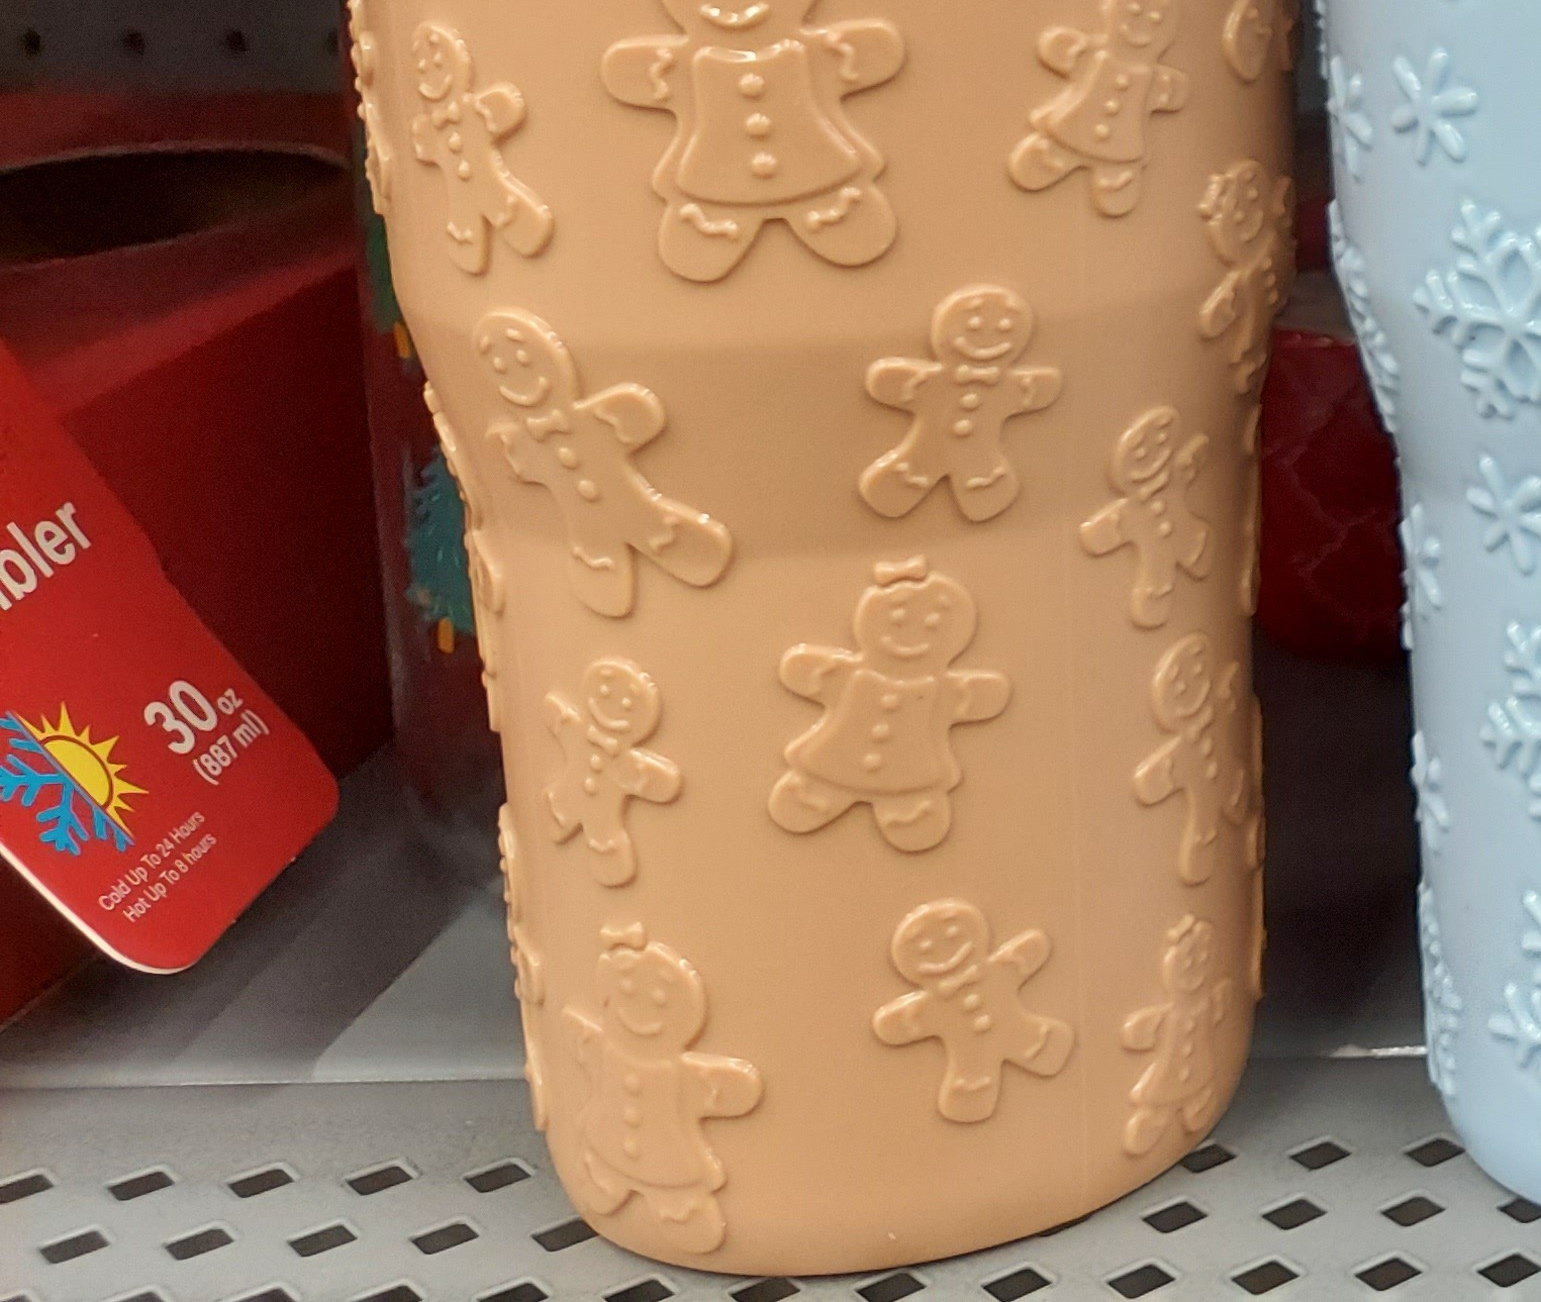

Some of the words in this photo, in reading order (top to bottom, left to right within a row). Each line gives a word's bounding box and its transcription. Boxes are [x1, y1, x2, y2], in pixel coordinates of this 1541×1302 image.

[0, 502, 91, 610] bler
[144, 680, 217, 754] 30
[217, 688, 243, 715] oz
[192, 734, 237, 786] (887
[233, 709, 269, 748] ml)
[98, 878, 132, 911] Cold
[124, 867, 148, 885] Up
[140, 853, 162, 869] To
[155, 838, 175, 857] 24
[168, 811, 205, 843] Hours
[181, 833, 217, 865] hours
[159, 869, 180, 885] To
[174, 859, 189, 873] 8
[143, 882, 167, 901] Up
[122, 897, 151, 922] Hot
